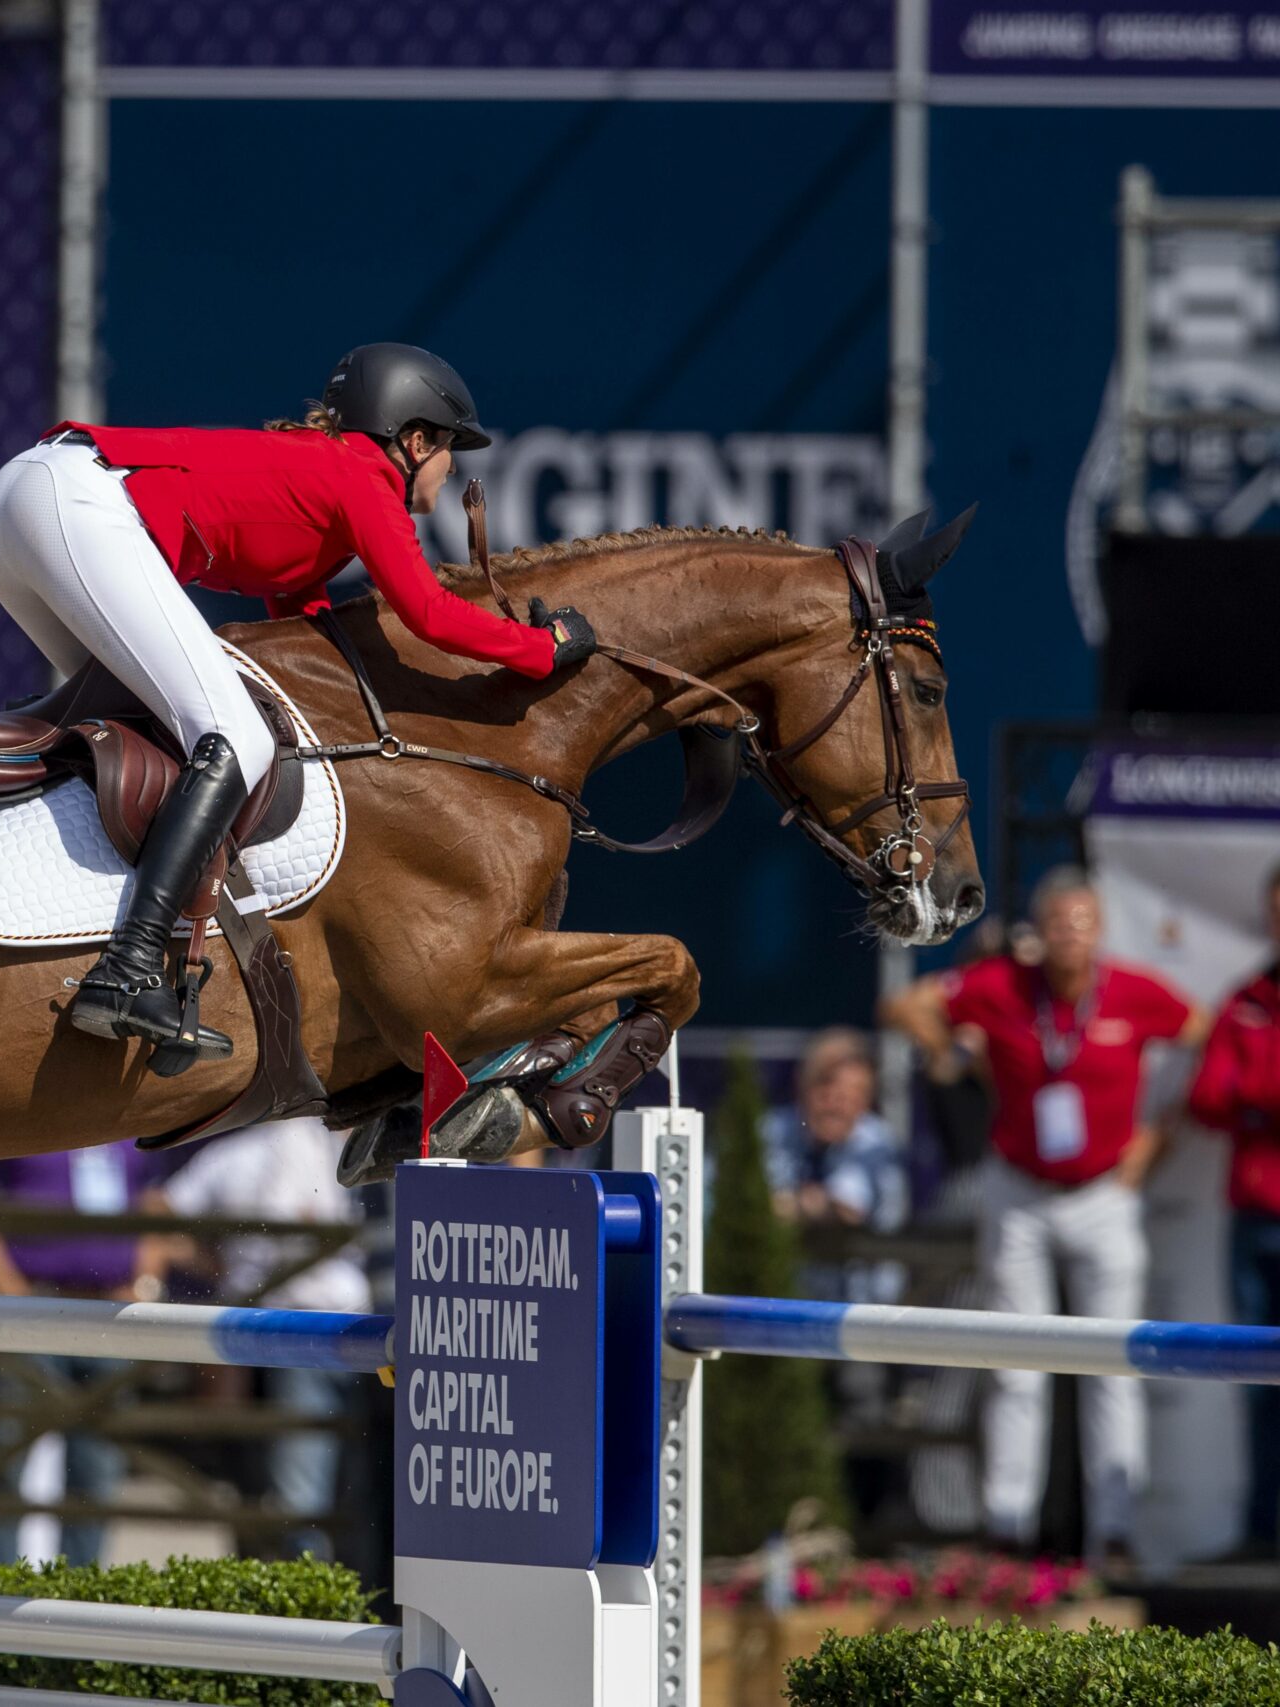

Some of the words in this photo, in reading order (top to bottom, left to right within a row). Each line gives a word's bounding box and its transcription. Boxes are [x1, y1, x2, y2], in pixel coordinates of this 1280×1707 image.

[889, 670, 900, 691] CWD
[406, 743, 428, 754] CWD
[211, 878, 221, 896] CWD
[412, 1220, 578, 1291] ROTTERDAM.
[409, 1295, 539, 1362] MARITIME
[408, 1368, 514, 1435] CAPITAL
[408, 1443, 443, 1505] OF
[451, 1446, 559, 1515] EUROPE.
